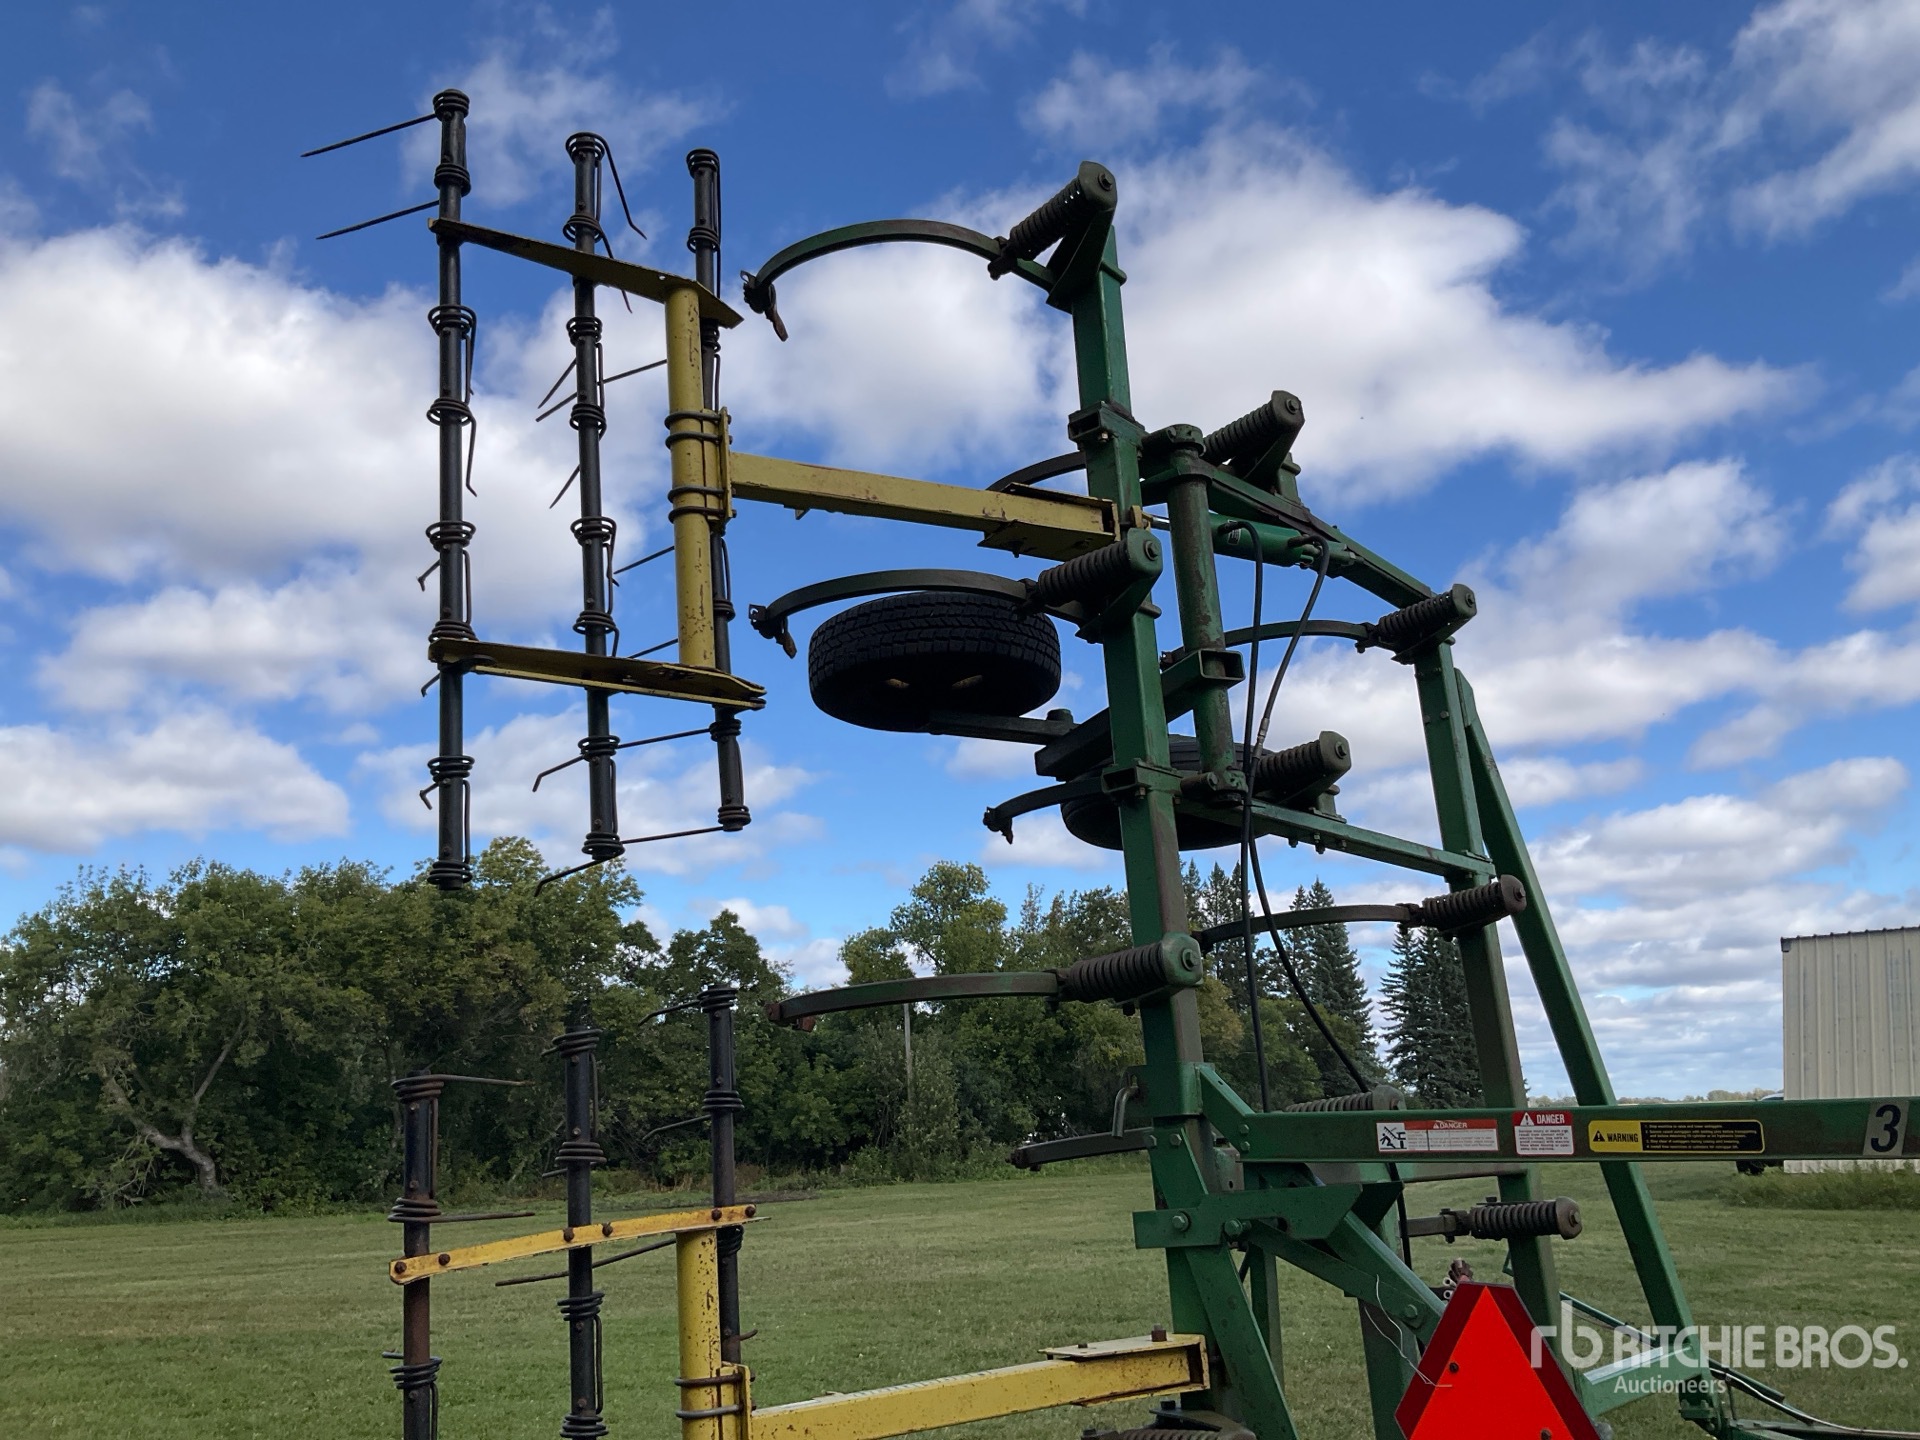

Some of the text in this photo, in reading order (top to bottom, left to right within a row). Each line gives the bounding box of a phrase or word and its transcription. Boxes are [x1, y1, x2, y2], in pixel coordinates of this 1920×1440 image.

[1536, 1114, 1565, 1124] DANGER
[1871, 1104, 1901, 1152] 3
[1607, 1133, 1639, 1143] WARNING
